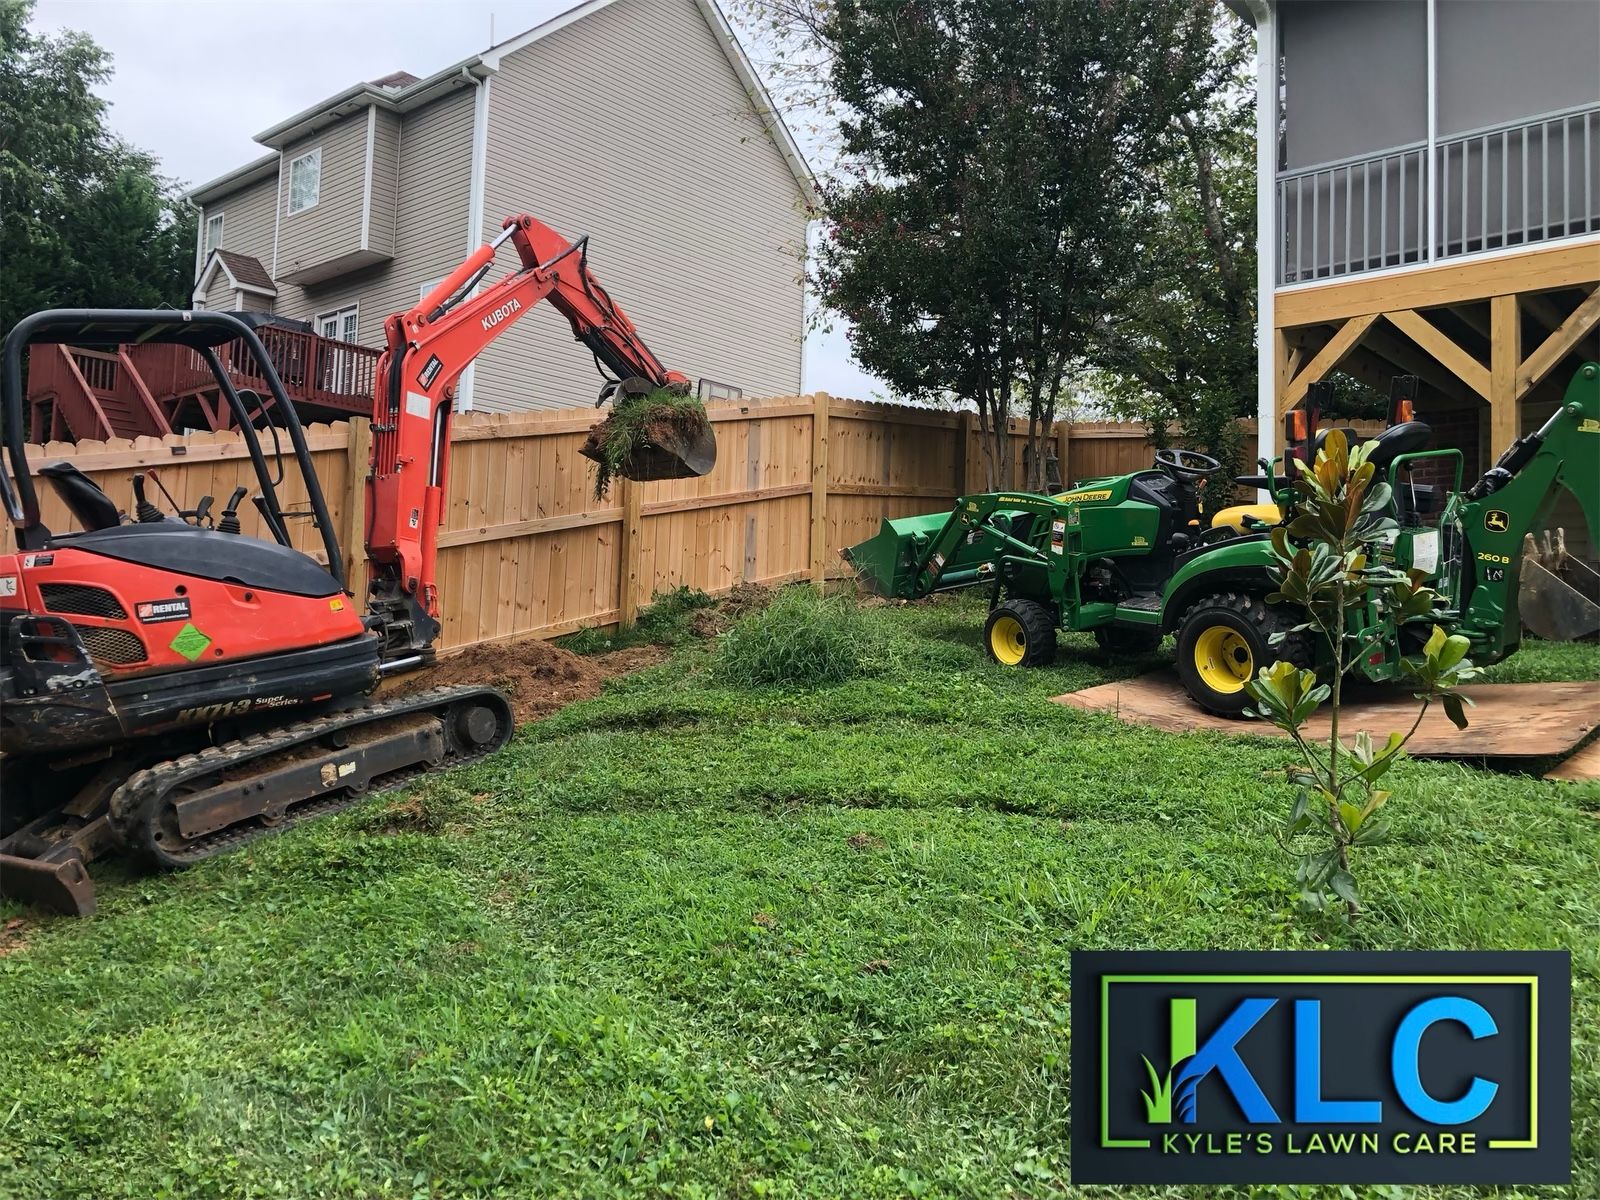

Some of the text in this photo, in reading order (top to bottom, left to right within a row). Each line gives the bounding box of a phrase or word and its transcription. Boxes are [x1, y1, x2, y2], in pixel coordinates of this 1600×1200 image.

[481, 298, 522, 331] KUBOTA
[1064, 493, 1108, 504] JOHN DEERE
[1477, 552, 1510, 564] 260 B
[153, 602, 188, 614] RENTAL
[255, 695, 284, 706] Super
[269, 698, 299, 708] Series
